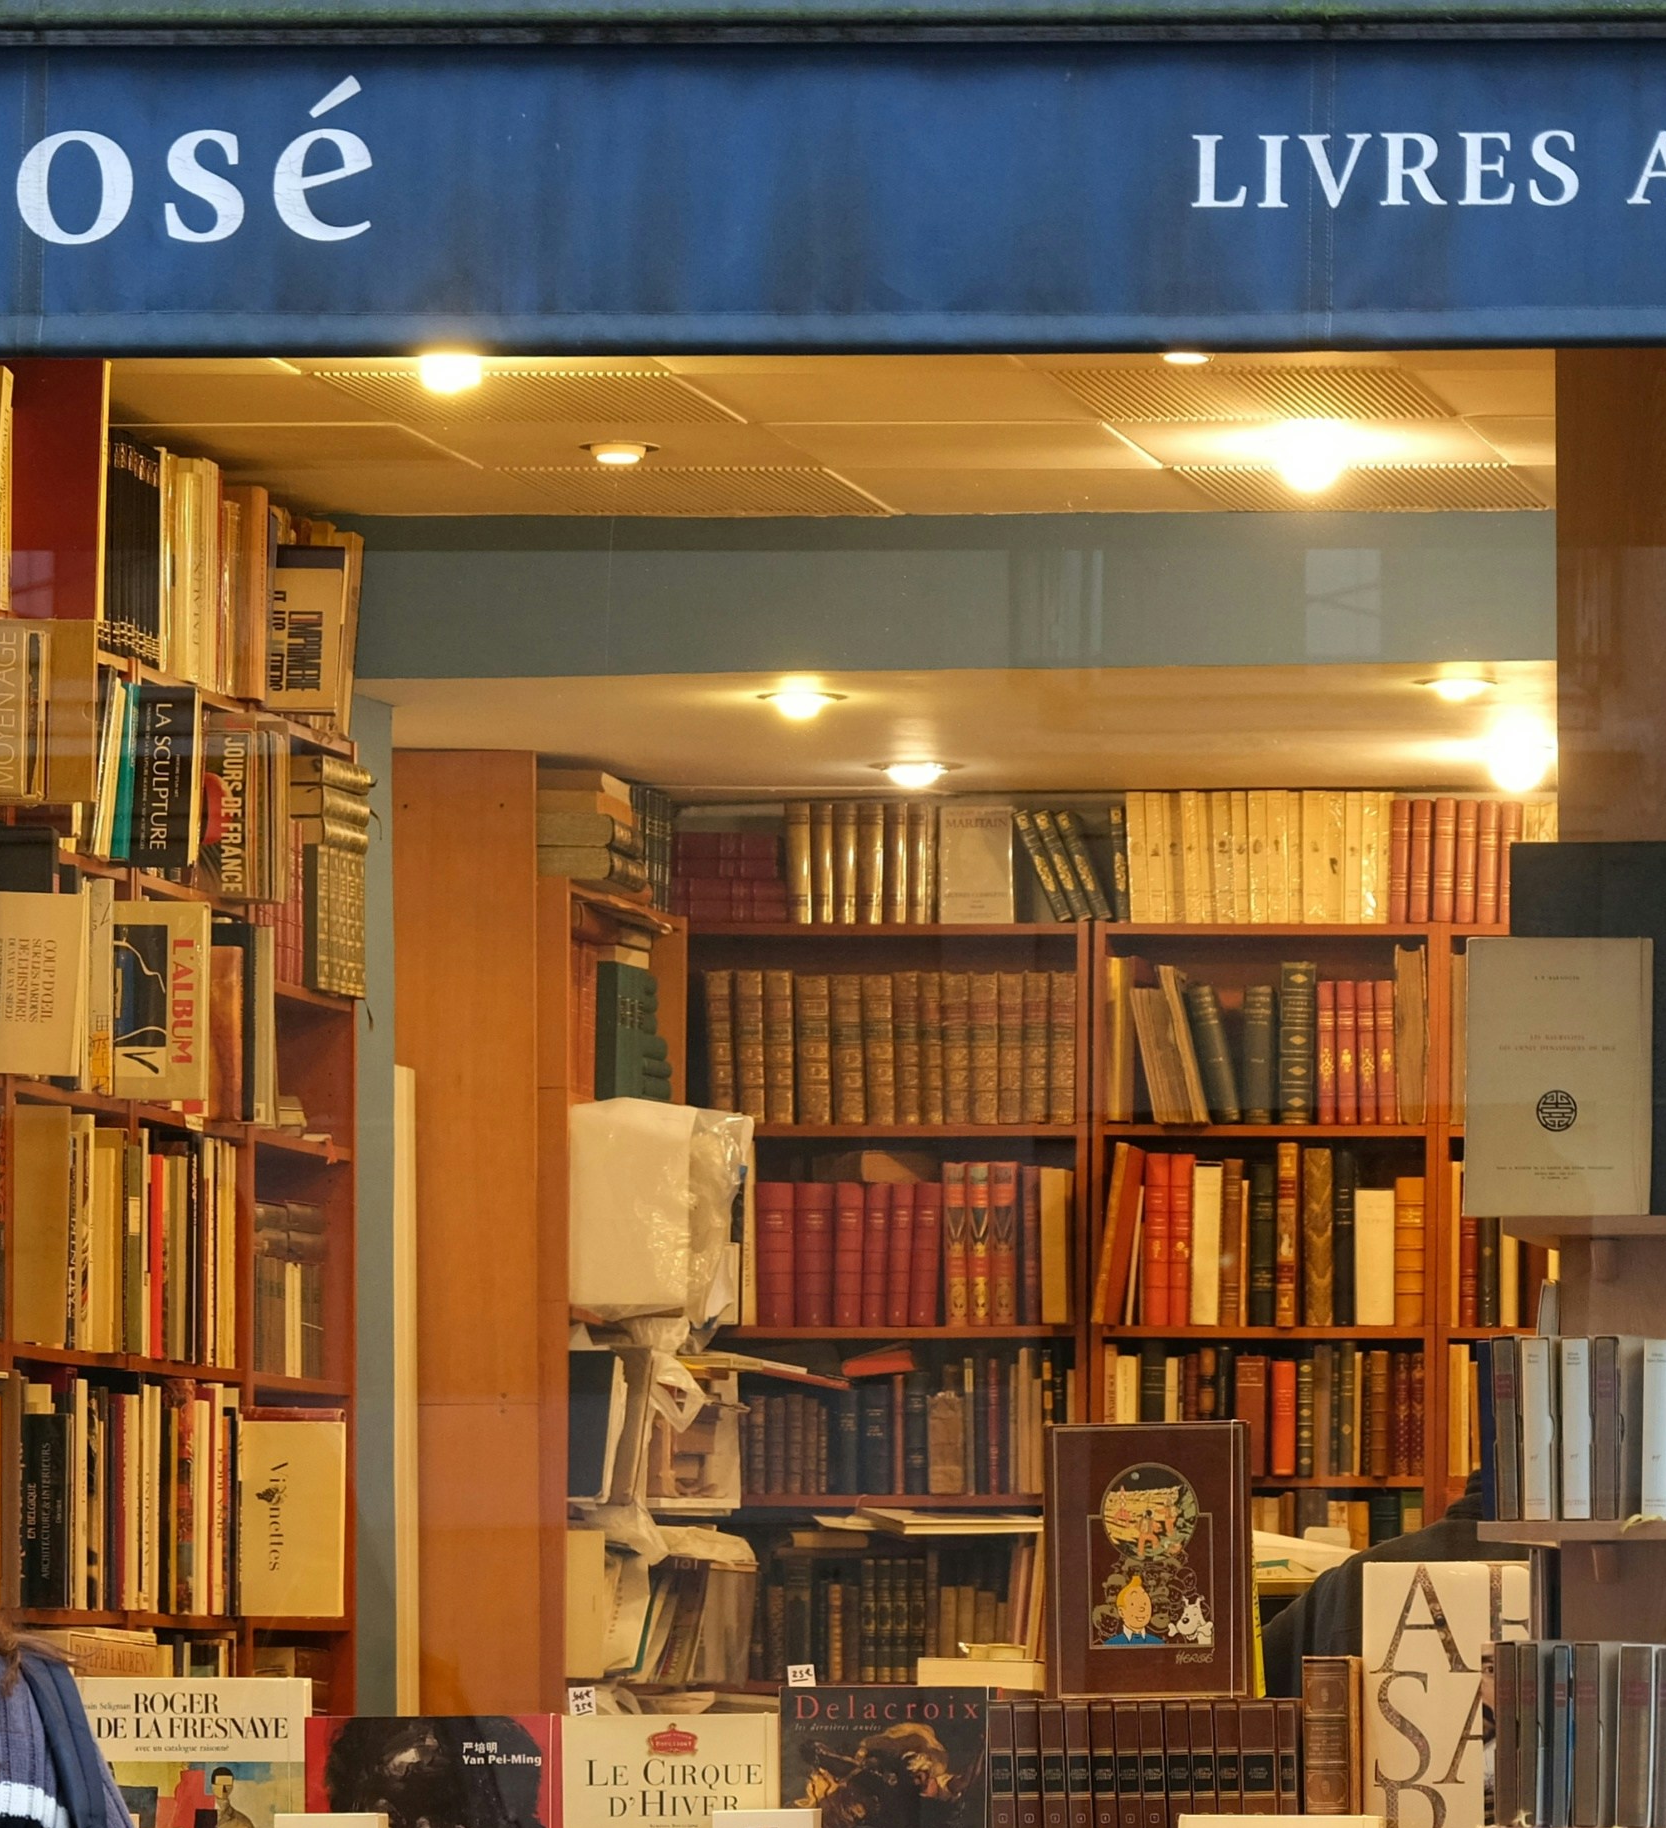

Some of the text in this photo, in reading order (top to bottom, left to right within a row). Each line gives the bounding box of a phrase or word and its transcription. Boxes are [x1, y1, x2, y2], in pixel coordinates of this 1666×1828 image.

[1191, 129, 1579, 210] LIVRES
[220, 745, 245, 893] JOURS DE FRANCE
[171, 939, 195, 1065] L'ALBUM
[133, 1692, 219, 1715] ROGER
[795, 1695, 980, 1720] Delacroix
[96, 1717, 288, 1740] DE LA FRESNAYE
[462, 1742, 498, 1754] 严培明
[462, 1755, 542, 1767] Yan Pei-Ming
[586, 1758, 763, 1790] LE CIRQUE
